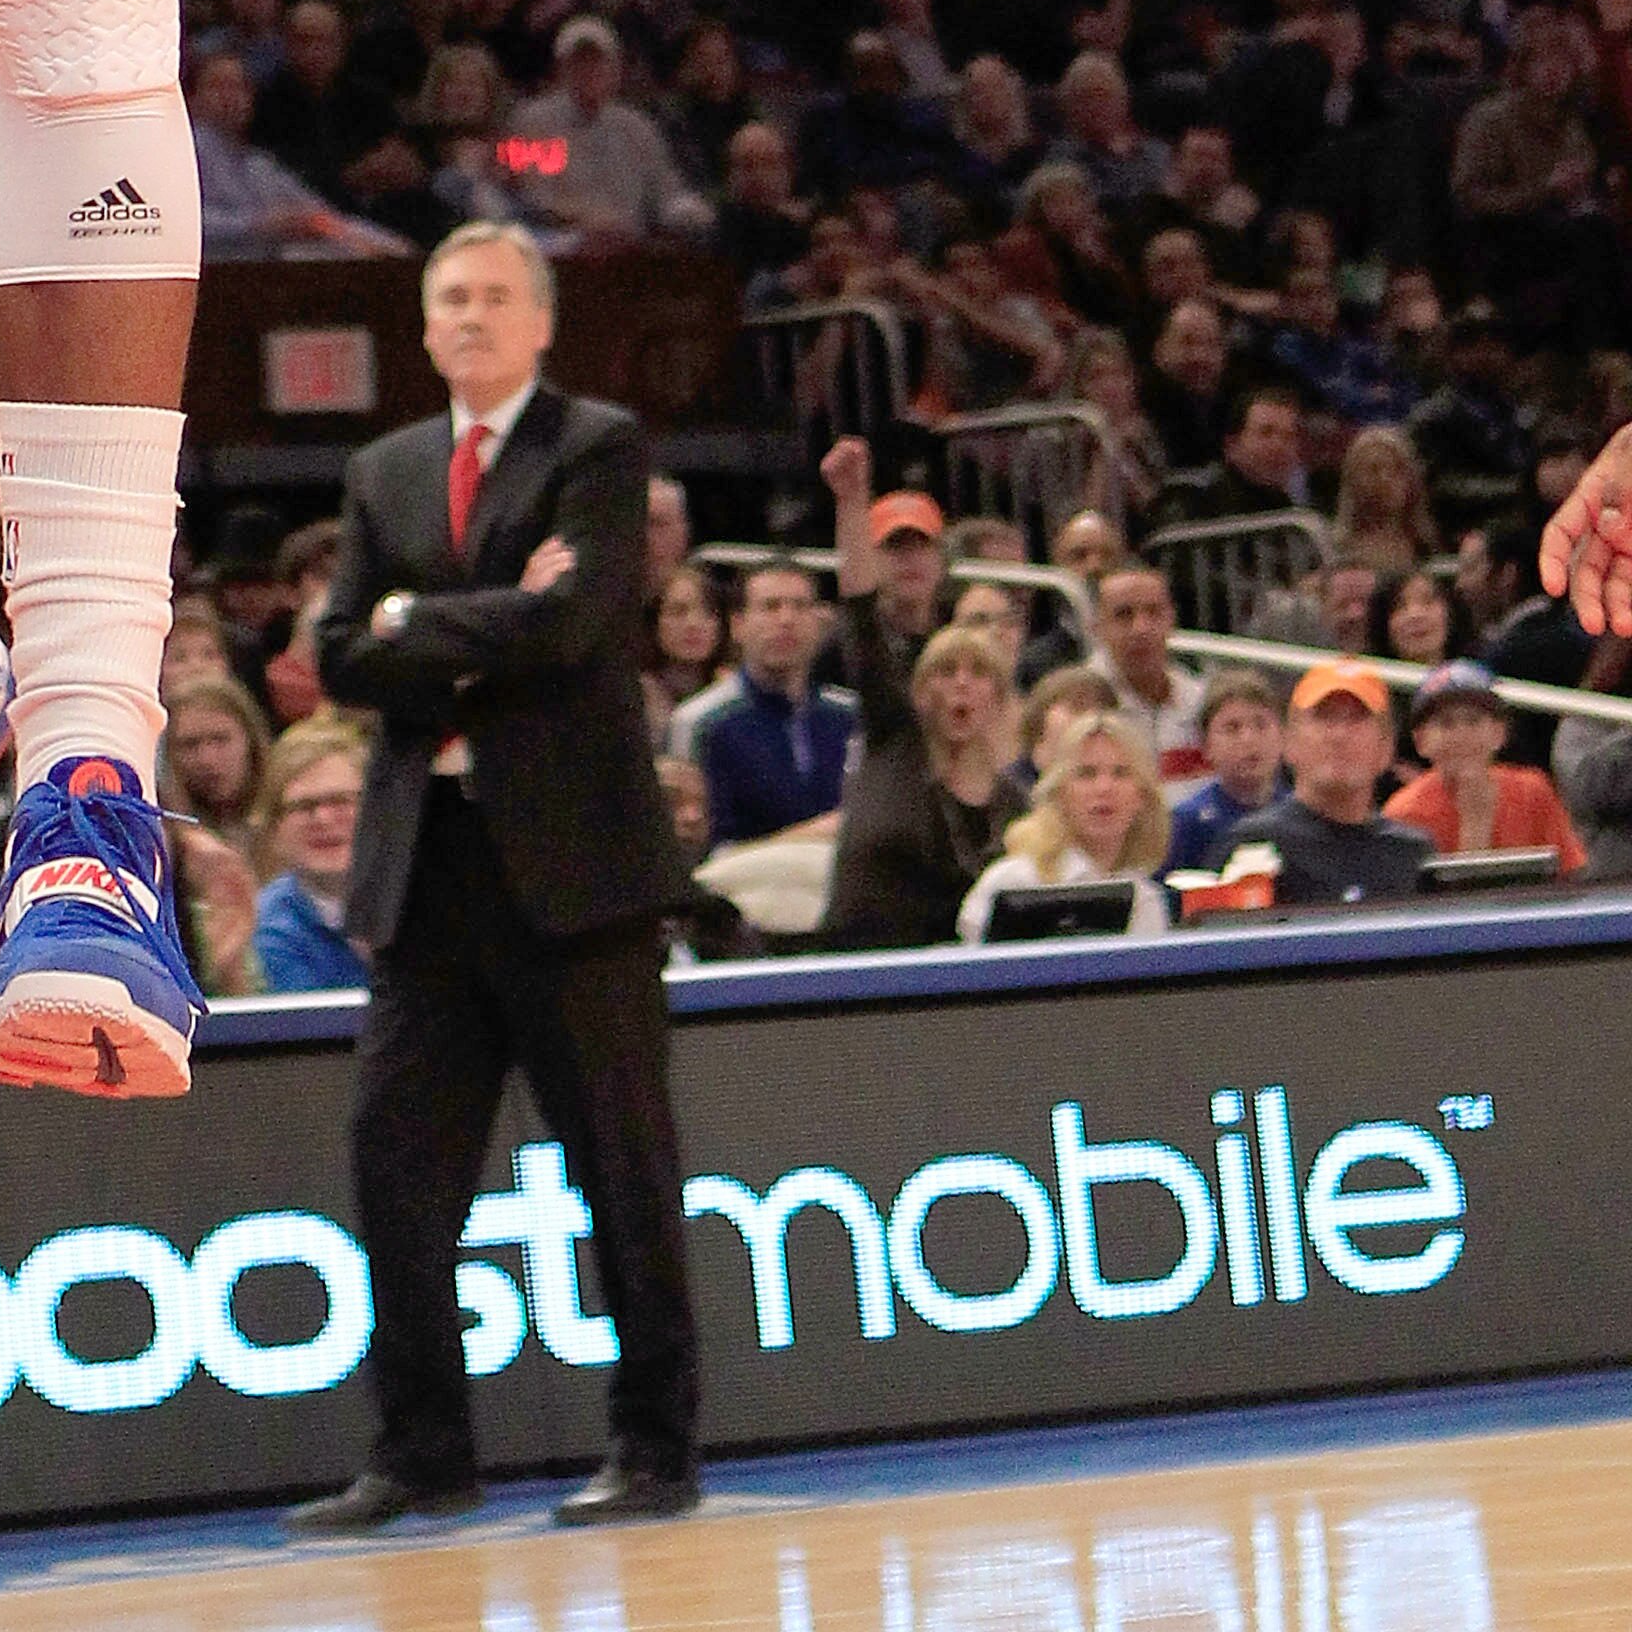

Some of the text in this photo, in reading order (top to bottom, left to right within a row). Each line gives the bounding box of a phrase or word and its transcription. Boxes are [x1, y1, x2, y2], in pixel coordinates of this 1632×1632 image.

[69, 205, 161, 222] adidas
[28, 862, 133, 899] NIK
[682, 1086, 1468, 1351] mobile
